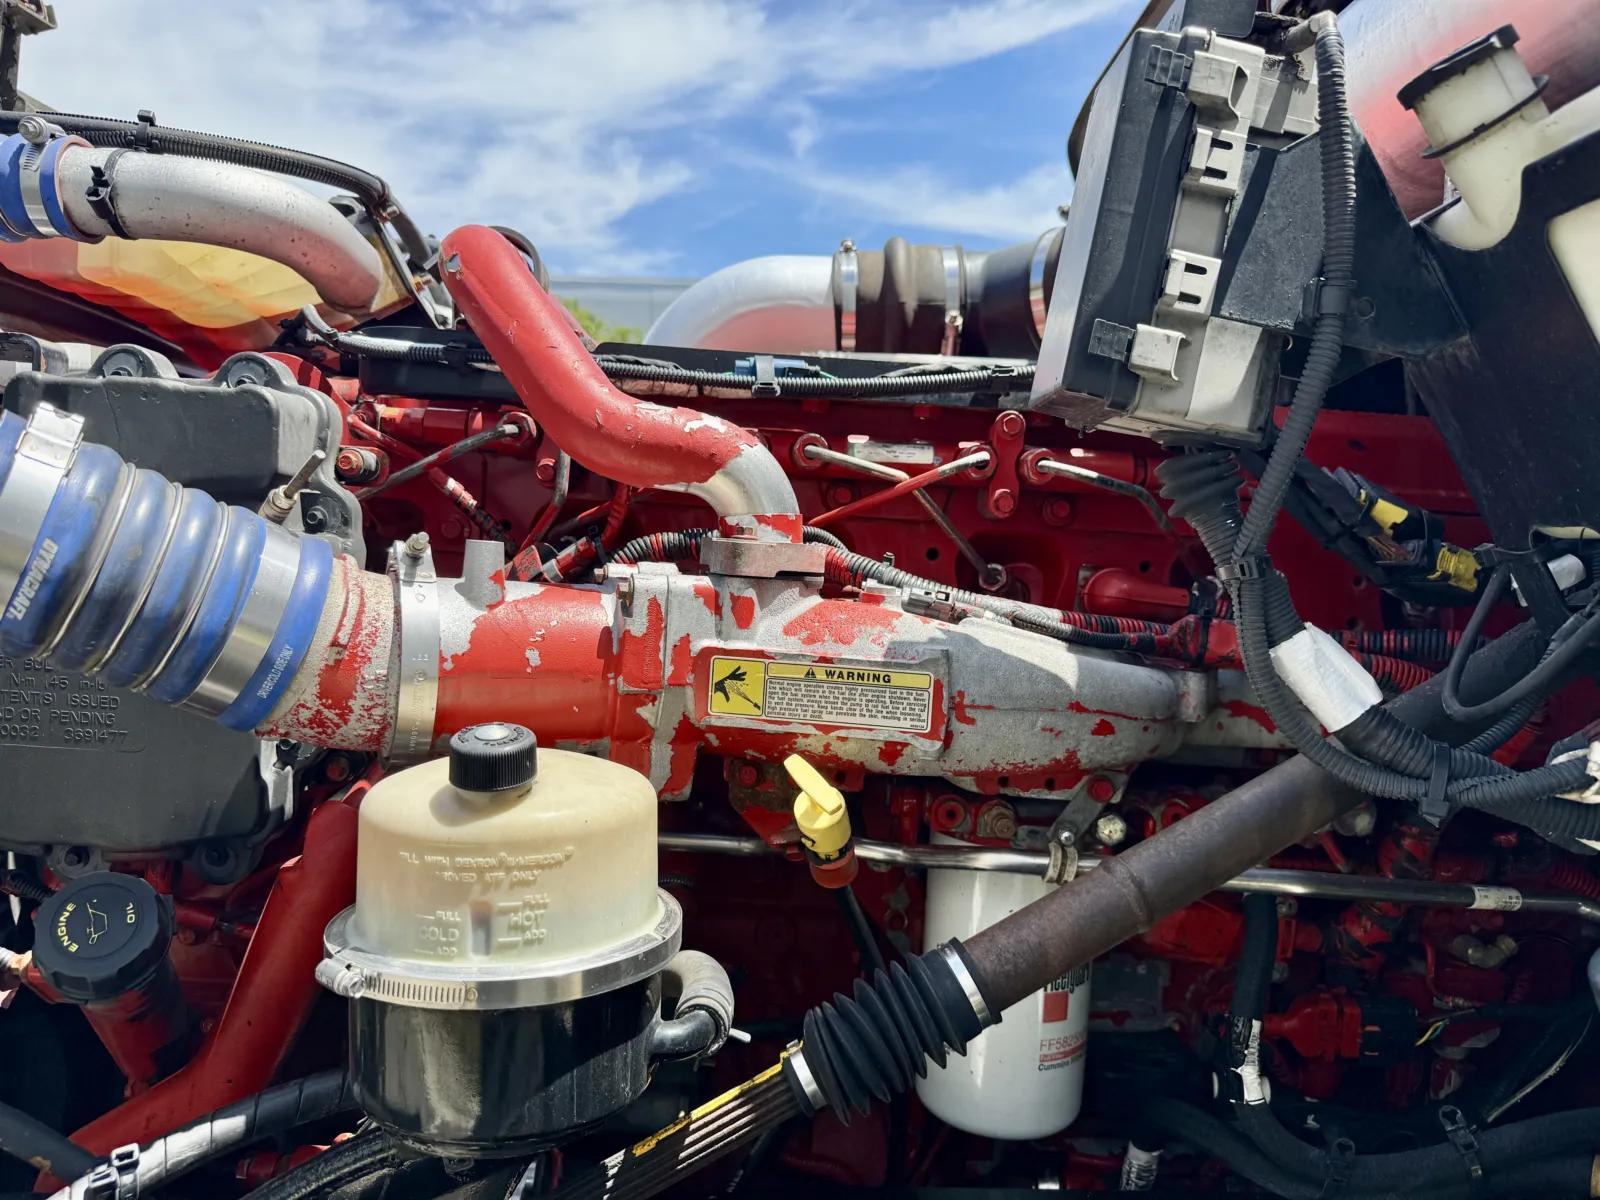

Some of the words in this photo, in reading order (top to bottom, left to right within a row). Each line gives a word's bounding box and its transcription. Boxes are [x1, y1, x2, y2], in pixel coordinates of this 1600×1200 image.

[825, 669, 892, 683] WARNING
[0, 689, 56, 704] TENT(S)
[67, 693, 120, 708] ISSUED
[50, 709, 116, 725] PENDING
[512, 869, 543, 881] ONLY
[126, 902, 135, 923] OIL
[511, 910, 546, 926] HOT
[57, 902, 79, 952] ENGINE
[419, 926, 459, 942] COLD
[524, 928, 547, 940] ADD
